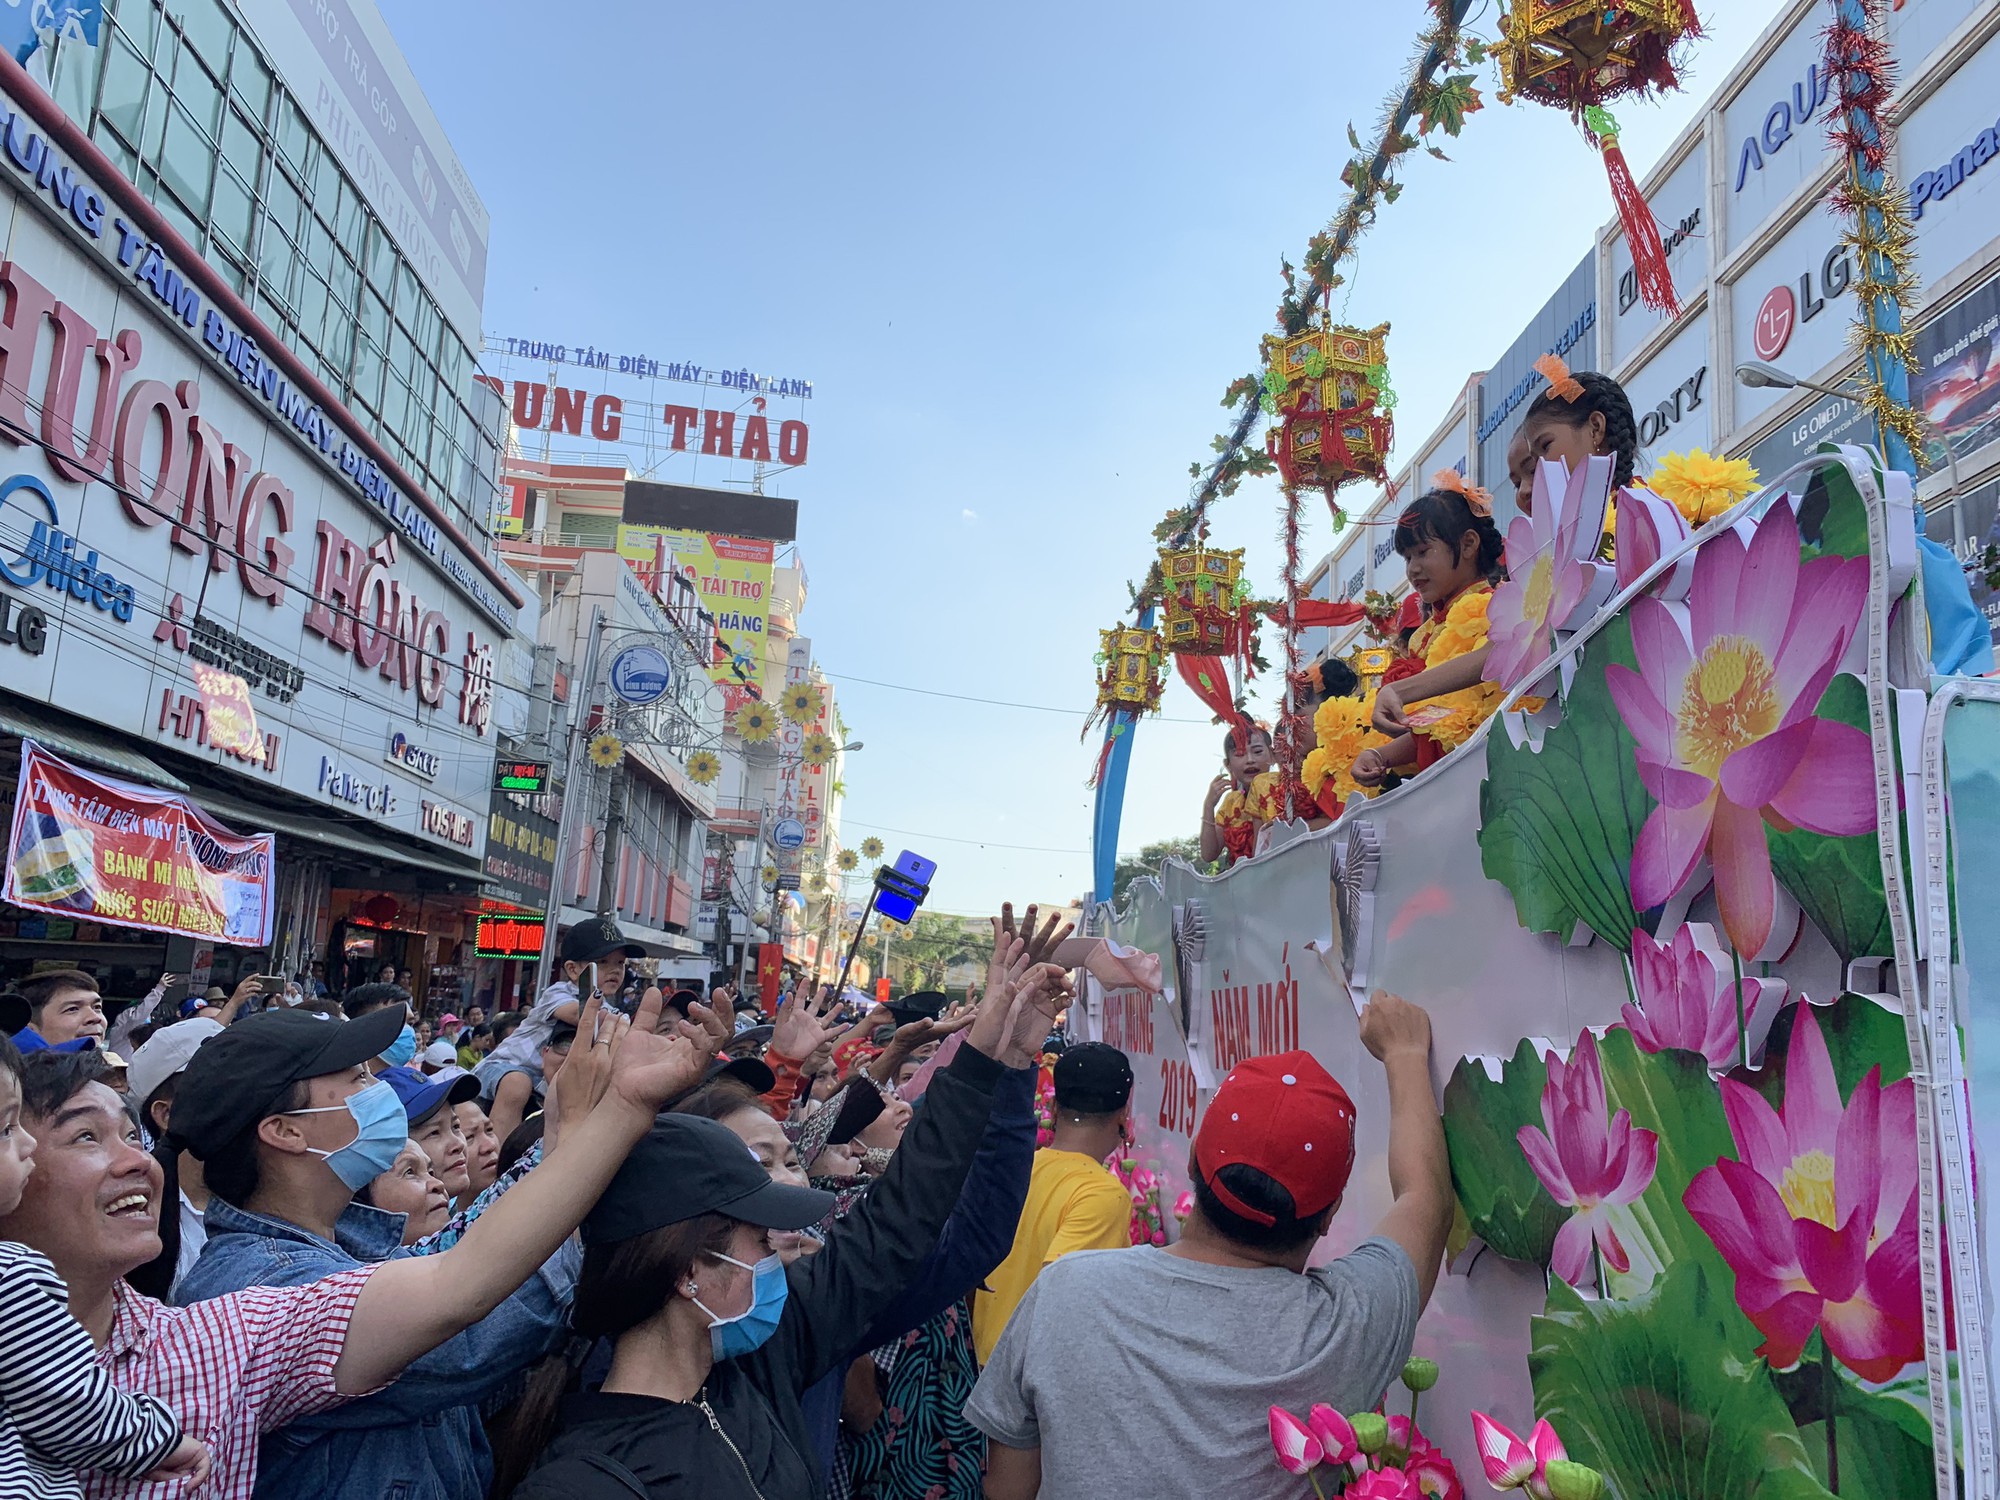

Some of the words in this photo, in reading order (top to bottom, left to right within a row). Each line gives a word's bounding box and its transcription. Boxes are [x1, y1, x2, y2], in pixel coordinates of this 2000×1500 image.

[307, 0, 341, 42] RỢ
[1909, 113, 2000, 221] Pana
[1801, 244, 1851, 323] LG
[0, 104, 106, 240] UNG
[115, 217, 201, 328] TÂM
[203, 308, 279, 401] ĐIỆN
[340, 442, 390, 511] ĐIỆN
[389, 491, 440, 556] LẠNH
[507, 337, 567, 364] TRUNG
[576, 346, 610, 371] TÂM
[619, 354, 659, 380] ĐIỆN
[669, 360, 702, 383] MÁY
[721, 367, 761, 394] ĐIỆN
[769, 376, 814, 399] LẠNH
[474, 374, 623, 442] UNG
[664, 396, 809, 466] THẢO
[1637, 366, 1707, 448] ONY
[1792, 424, 1808, 447] LG
[1809, 402, 1841, 434] OLED
[701, 573, 727, 596] TÀI
[730, 581, 765, 602] TRỢ
[719, 610, 763, 633] HÃNG
[77, 796, 112, 826] TÂM
[108, 808, 141, 836] ĐIỆN
[142, 814, 174, 842] MÁY
[420, 799, 474, 849] TOSHIBA
[103, 846, 148, 882] BÁNH
[153, 857, 173, 887] MÌ
[94, 886, 137, 921] NƯỚC
[141, 894, 175, 927] SUỐI
[1211, 968, 1252, 1071] NĂM
[1257, 941, 1299, 1057] MỚI
[1158, 1057, 1197, 1139] 2019
